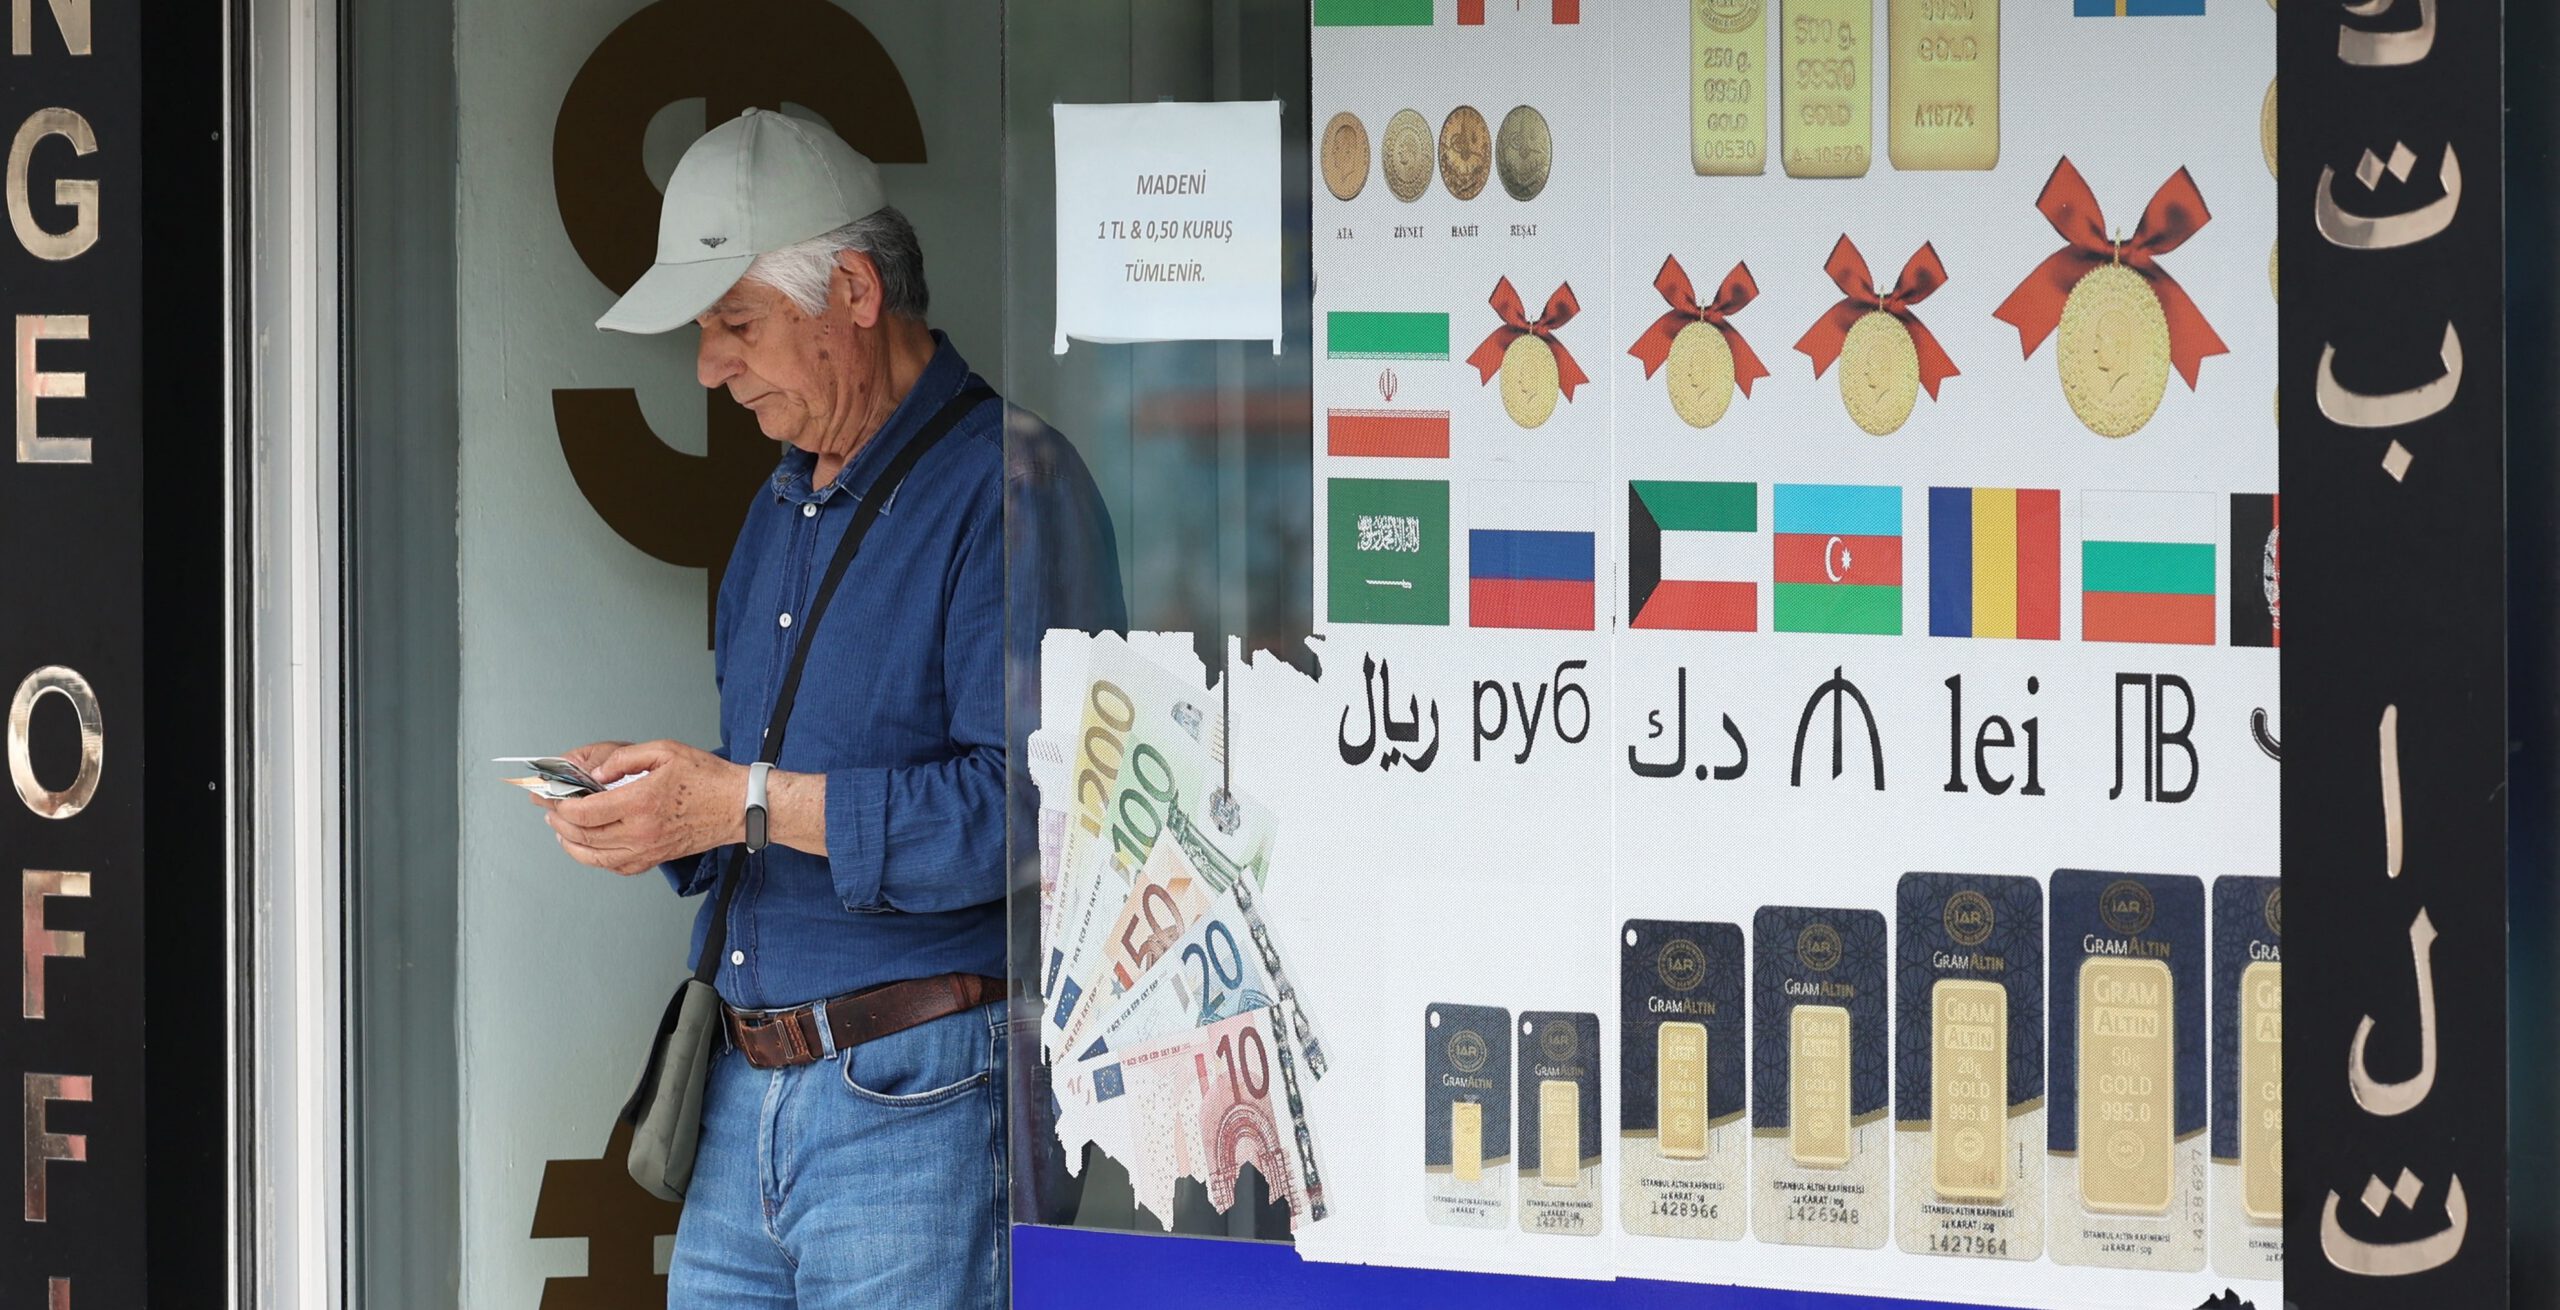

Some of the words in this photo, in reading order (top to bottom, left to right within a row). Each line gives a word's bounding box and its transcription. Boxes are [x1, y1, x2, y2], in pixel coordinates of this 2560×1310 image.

[1795, 14, 1832, 44] 500
[1703, 47, 1733, 69] 250
[1918, 35, 1978, 61] GOLD
[1707, 112, 1748, 132] GOLD
[1801, 104, 1852, 127] GOLD
[1914, 103, 1975, 128] A16724
[1703, 140, 1757, 160] 00530
[1136, 169, 1206, 195] MADENİ
[1098, 221, 1106, 240] 1
[1111, 221, 1126, 240] TL
[1130, 221, 1142, 239] &
[1146, 220, 1178, 242] 0,50
[1182, 219, 1233, 243] KURUŞ
[1336, 227, 1354, 240] ATA
[1393, 224, 1424, 239] ZİYNET
[1451, 223, 1479, 238] HAMİT
[1510, 224, 1538, 240] REŞAT
[1125, 258, 1206, 283] TÜMLENİR.
[1473, 660, 1591, 765] руб
[1077, 680, 1136, 811] 200
[1943, 673, 2046, 797] lei
[1112, 743, 1178, 865] 100
[1954, 910, 1981, 924] IAR
[2112, 899, 2140, 914] IAR
[1121, 883, 1185, 969] 50
[2083, 933, 2171, 957] GRAMALTIN
[1181, 920, 1243, 1019] 20
[1667, 957, 1694, 971] IAR
[1932, 950, 2004, 971] GRAMALTIN
[8, 665, 103, 1310] OFF
[1784, 978, 1854, 998] GRAMALTIN
[2093, 974, 2158, 1005] GRAM
[1648, 995, 1716, 1015] GRAMALTIN
[1945, 996, 1994, 1023] GRAM
[2097, 1009, 2155, 1035] ALTIN
[1946, 1026, 1992, 1049] ALTIN
[1215, 1026, 1270, 1103] 10
[1948, 1080, 1991, 1098] GOLD
[2099, 1074, 2152, 1096] GOLD
[1949, 1103, 1989, 1122] 995.0
[2101, 1101, 2151, 1123] 995.0
[1651, 1200, 1718, 1219] 1428966
[1802, 1195, 1828, 1205] KARAT
[2191, 1148, 2204, 1255] 1428627
[1788, 1205, 1859, 1225] 1426948
[1951, 1219, 1977, 1229] KARAT
[1929, 1234, 2007, 1255] 1427964
[2111, 1243, 2135, 1252] KARAT
